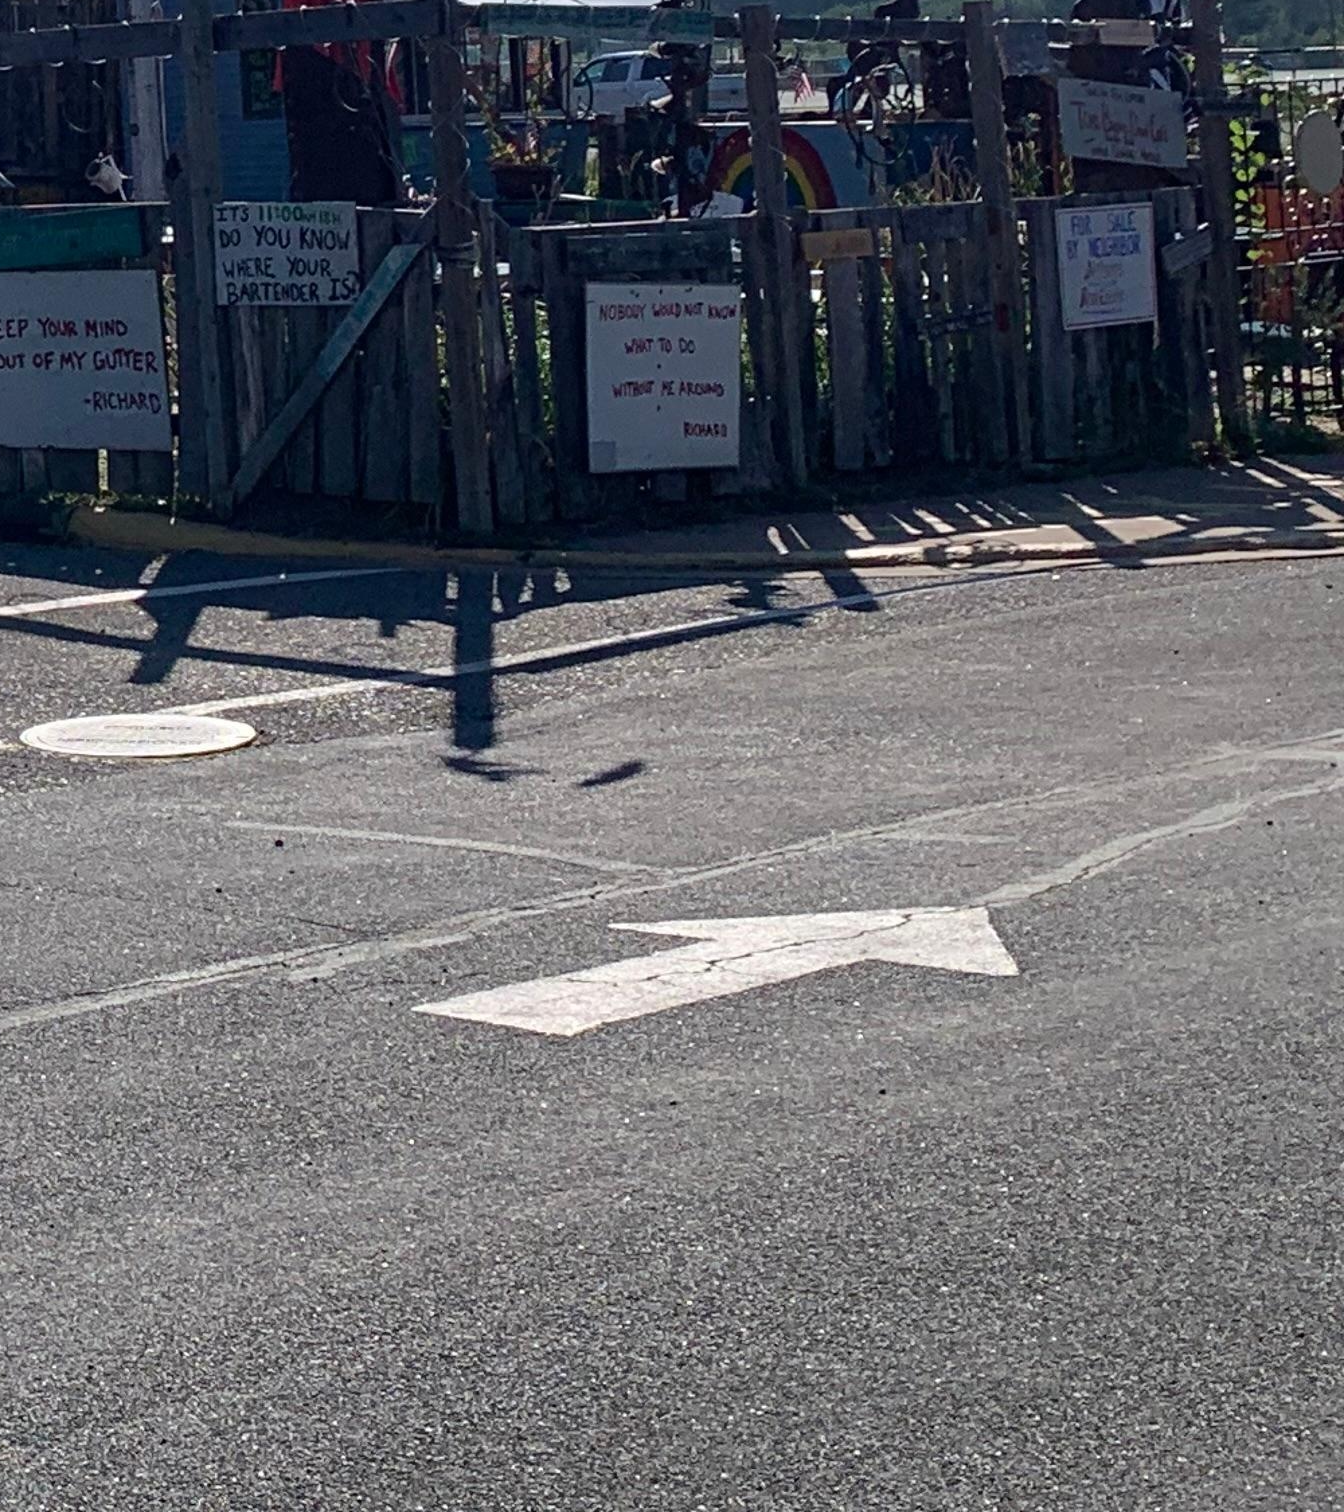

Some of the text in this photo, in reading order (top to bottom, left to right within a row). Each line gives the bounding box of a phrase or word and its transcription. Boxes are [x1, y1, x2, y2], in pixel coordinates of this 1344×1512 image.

[216, 206, 249, 222] ITS
[1071, 210, 1137, 236] FOR SALE
[219, 225, 350, 251] DO YOU KNOW
[222, 255, 332, 278] WHERE YOUR
[226, 281, 320, 305] BARTENDER
[599, 301, 738, 321] NOBODY WOULD NOT KNOW
[37, 317, 78, 339] YOUR
[85, 319, 128, 338] MIND
[624, 337, 697, 355] WHAT TO DO
[32, 351, 55, 370] OF
[60, 353, 88, 371] MY
[93, 348, 159, 374] GUTTER
[612, 380, 725, 398] WITHOUT ME AROUND
[683, 421, 728, 438] RICHARD
